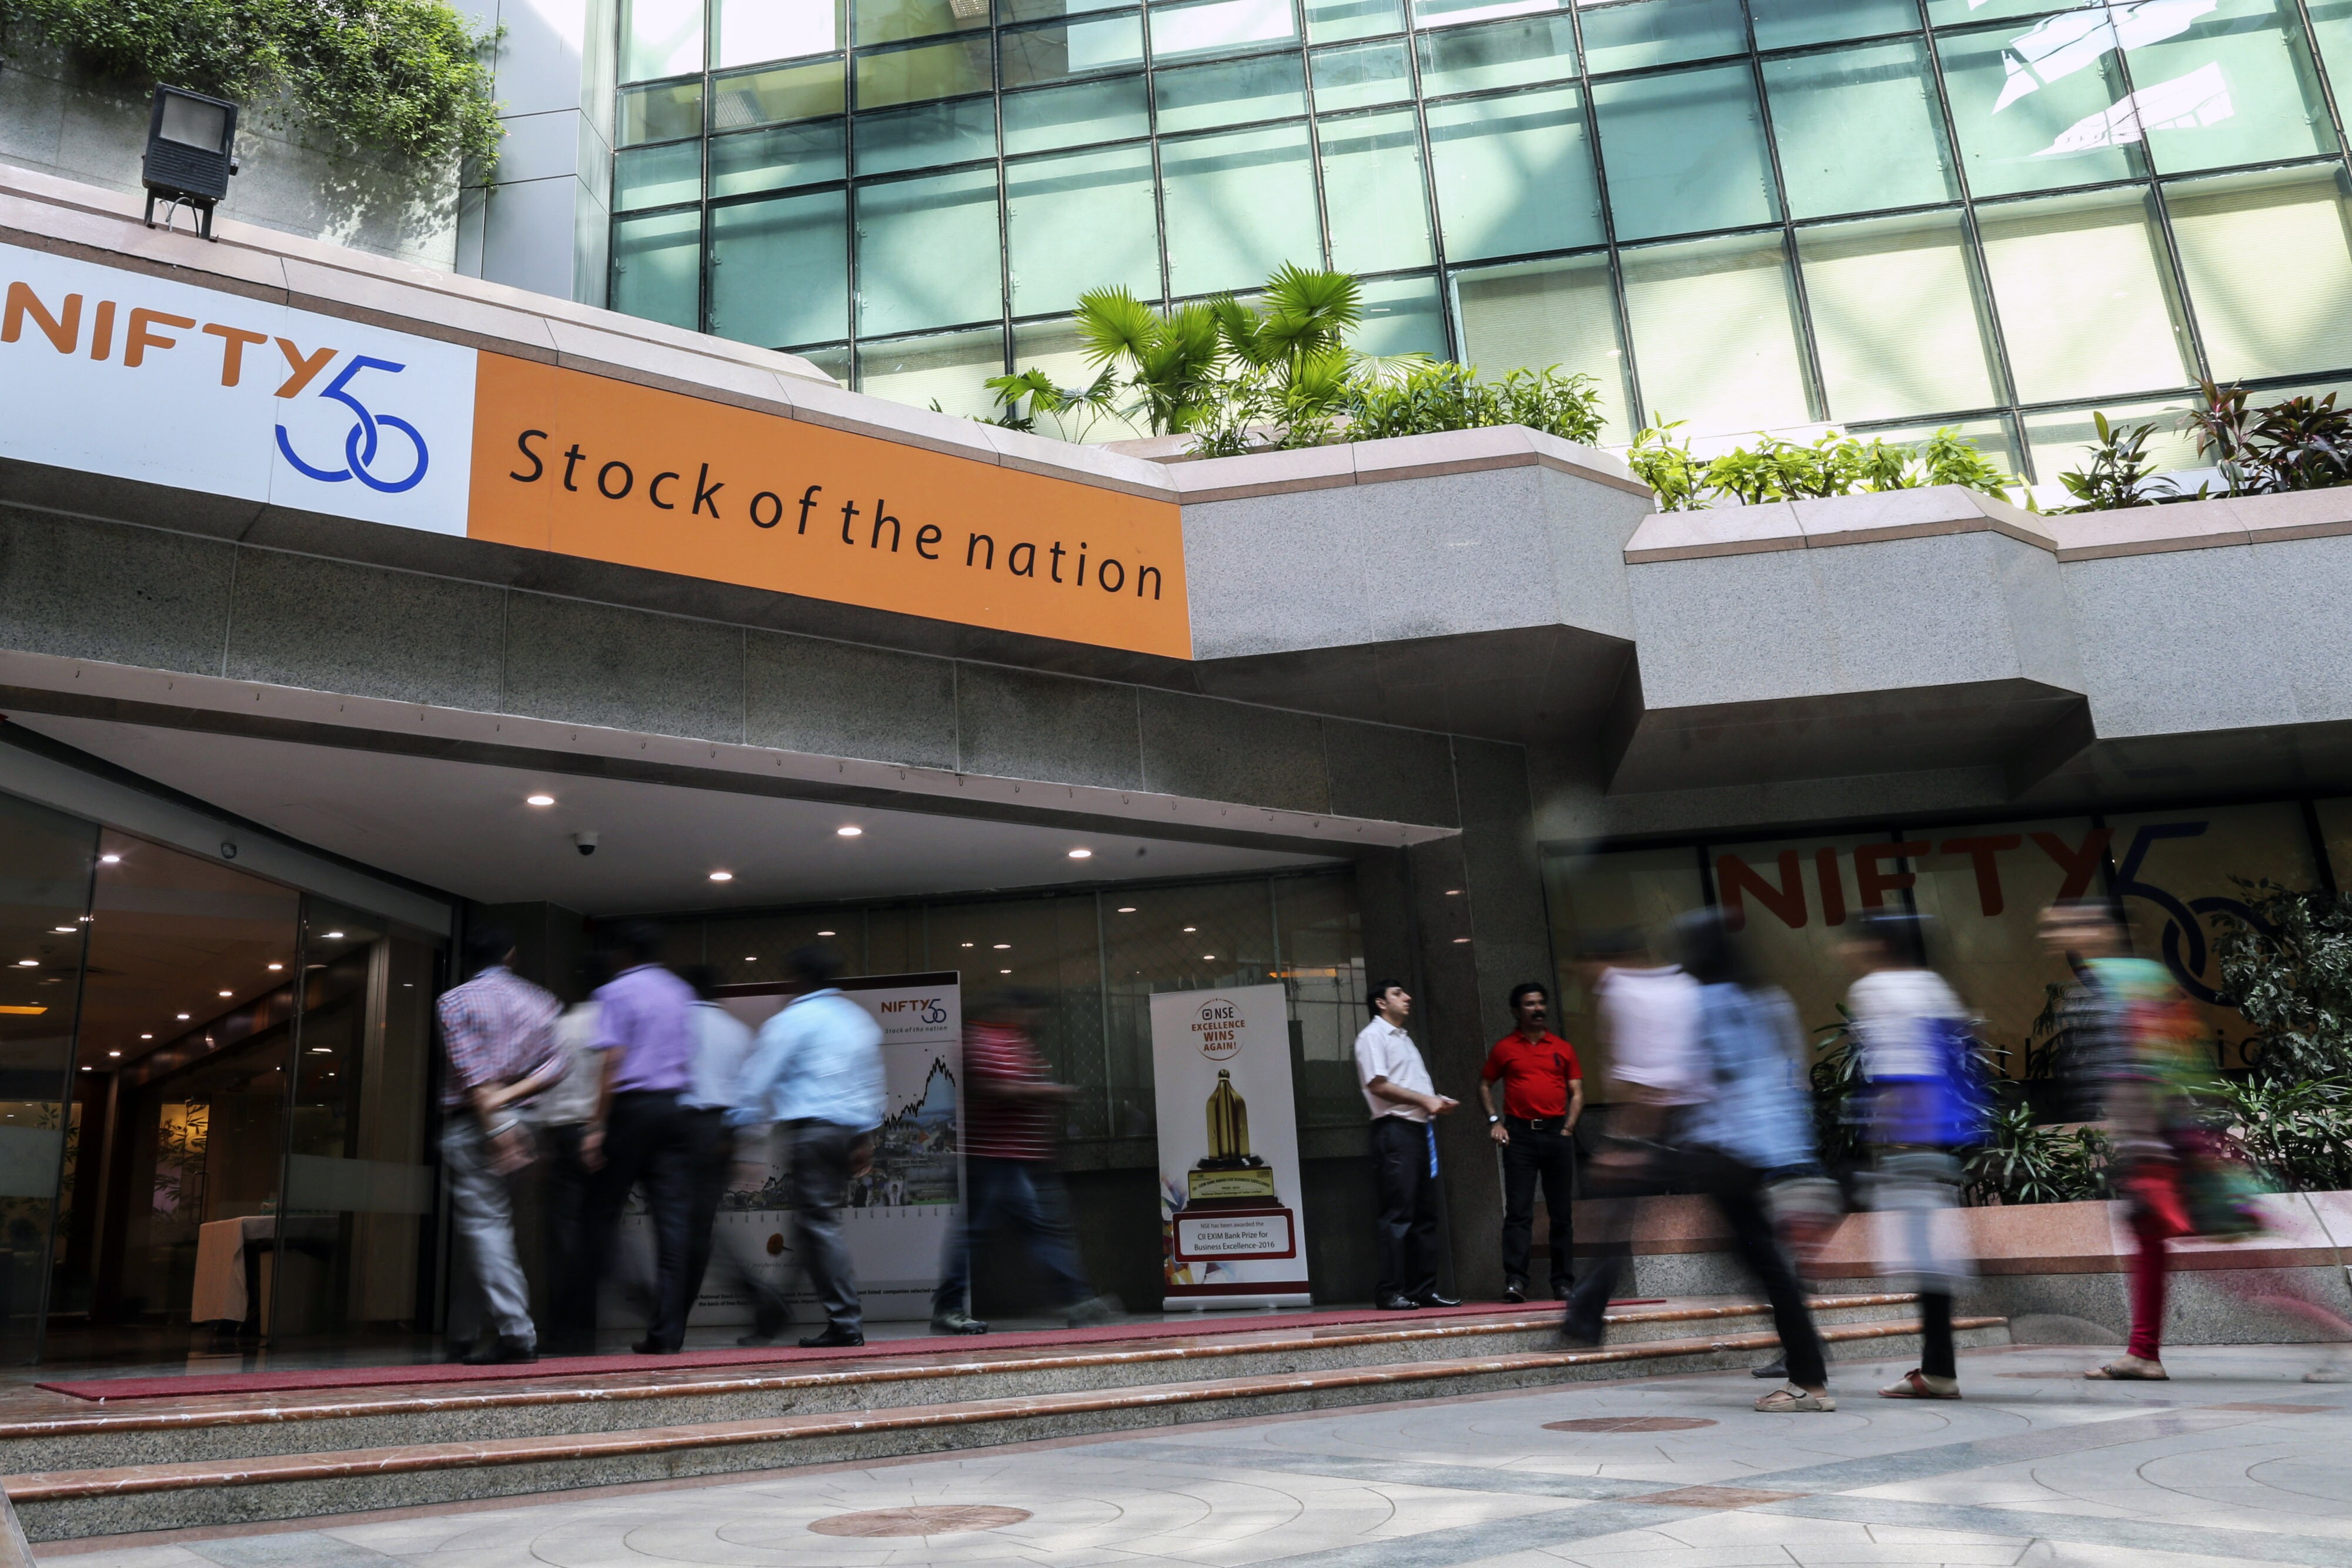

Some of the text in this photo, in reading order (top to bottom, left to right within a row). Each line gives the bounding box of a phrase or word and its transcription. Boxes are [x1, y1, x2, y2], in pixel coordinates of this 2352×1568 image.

[509, 429, 1162, 600] Stock of the nation
[1215, 1007, 1234, 1019] NSE
[1191, 1020, 1245, 1031] EXCELLENCE
[1203, 1030, 1234, 1042] WINS
[1204, 1041, 1237, 1051] AGAIN!
